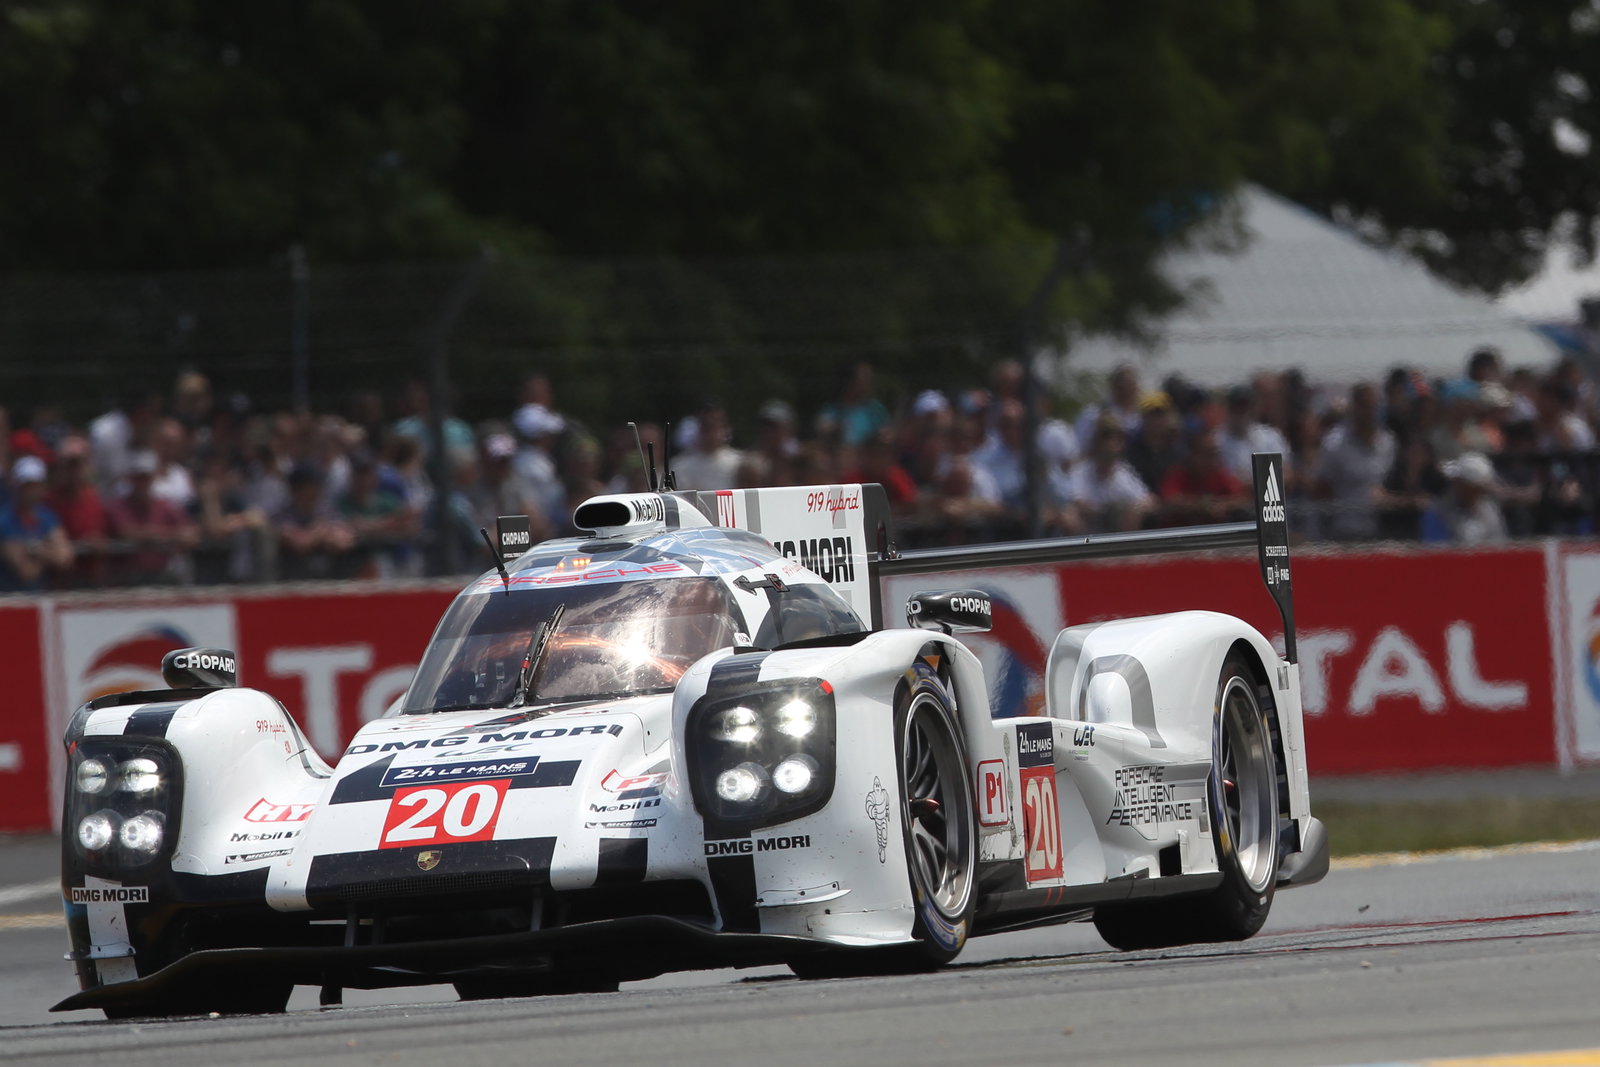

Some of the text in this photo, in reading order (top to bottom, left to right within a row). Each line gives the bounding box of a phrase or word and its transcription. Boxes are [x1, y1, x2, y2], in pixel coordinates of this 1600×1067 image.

[630, 497, 657, 522] Mobil
[807, 489, 859, 525] 919 hybrid
[1262, 501, 1285, 523] adidas
[502, 531, 530, 546] CHOPARD
[800, 536, 855, 583] MORI
[951, 597, 992, 616] CHOPARD
[173, 654, 236, 674] CHOPARD
[1270, 620, 1529, 717] TAL
[256, 720, 268, 733] 919
[1073, 725, 1095, 747] WEC
[345, 724, 624, 755] DMG MORI
[1029, 740, 1037, 753] LE
[1036, 737, 1052, 752] MANS
[437, 767, 466, 776] LE
[466, 762, 528, 774] MANS
[1114, 766, 1166, 788] PORSCHE
[985, 771, 1005, 815] P1
[1113, 784, 1176, 807] INTELLIGENT
[385, 784, 500, 843] 20
[589, 800, 642, 813] Mobil
[1106, 802, 1193, 826] PERFORMANCE
[606, 820, 656, 828] MICHELIN
[1026, 777, 1057, 870] 20
[230, 832, 283, 842] Mobil
[704, 835, 811, 856] DMG MORI
[73, 888, 147, 902] DMG MORI
